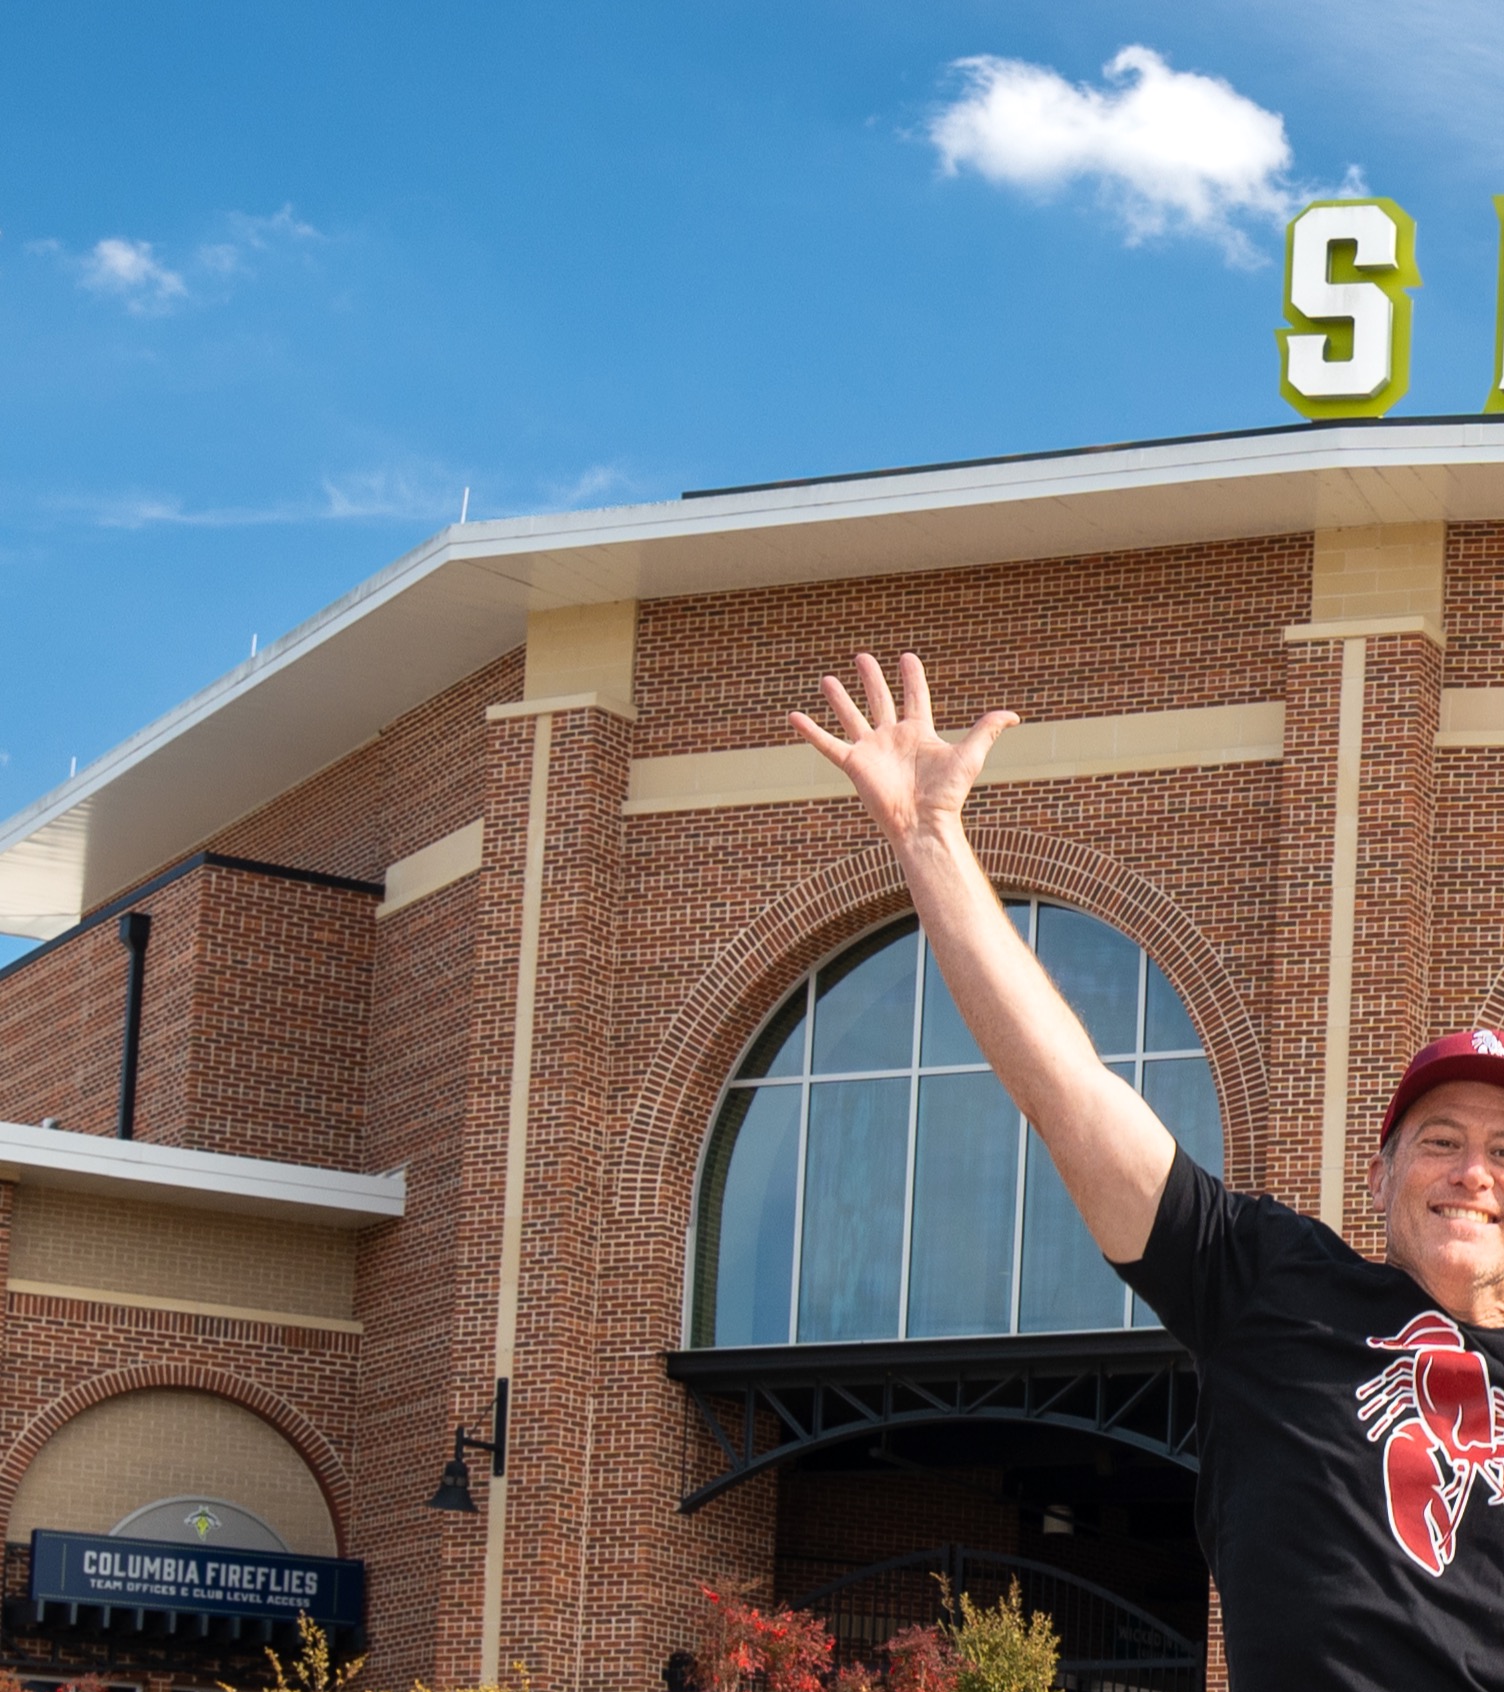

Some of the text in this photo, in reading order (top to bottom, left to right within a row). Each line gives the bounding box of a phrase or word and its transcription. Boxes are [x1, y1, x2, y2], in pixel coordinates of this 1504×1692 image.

[83, 1550, 318, 1595] COLUMBIA FIREFLIES
[90, 1578, 122, 1591] TEAM
[127, 1582, 176, 1596] OFFICES
[193, 1588, 223, 1600] CLUB
[226, 1591, 262, 1604] LEVEL
[266, 1595, 310, 1608] ACCESS
